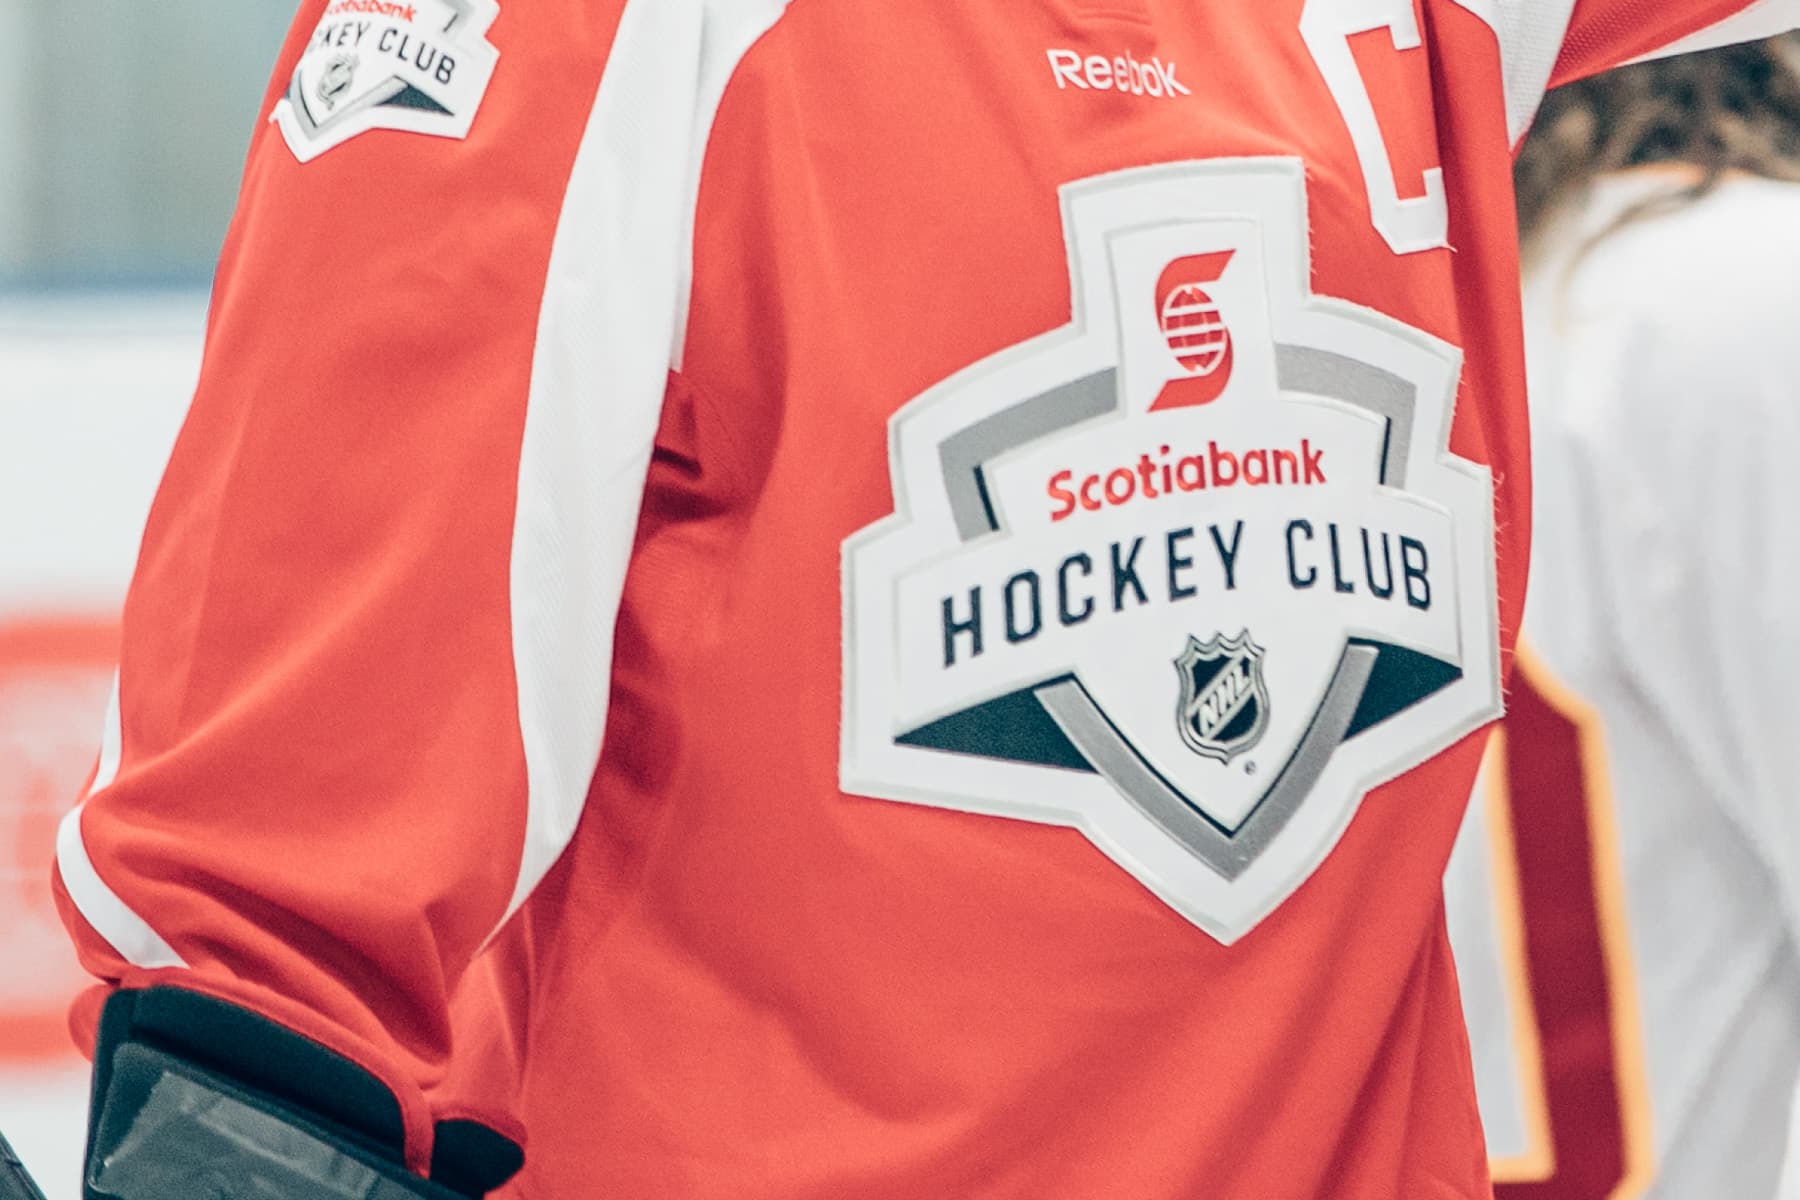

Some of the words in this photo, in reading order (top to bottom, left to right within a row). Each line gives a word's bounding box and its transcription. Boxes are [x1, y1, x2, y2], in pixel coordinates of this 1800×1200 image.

[377, 26, 457, 85] CLUB
[1045, 48, 1192, 99] Reebok
[1046, 437, 1328, 524] Scotiabank
[940, 518, 1246, 669] HOCKEY
[1284, 518, 1433, 613] CLUB
[1199, 662, 1252, 736] NHL
